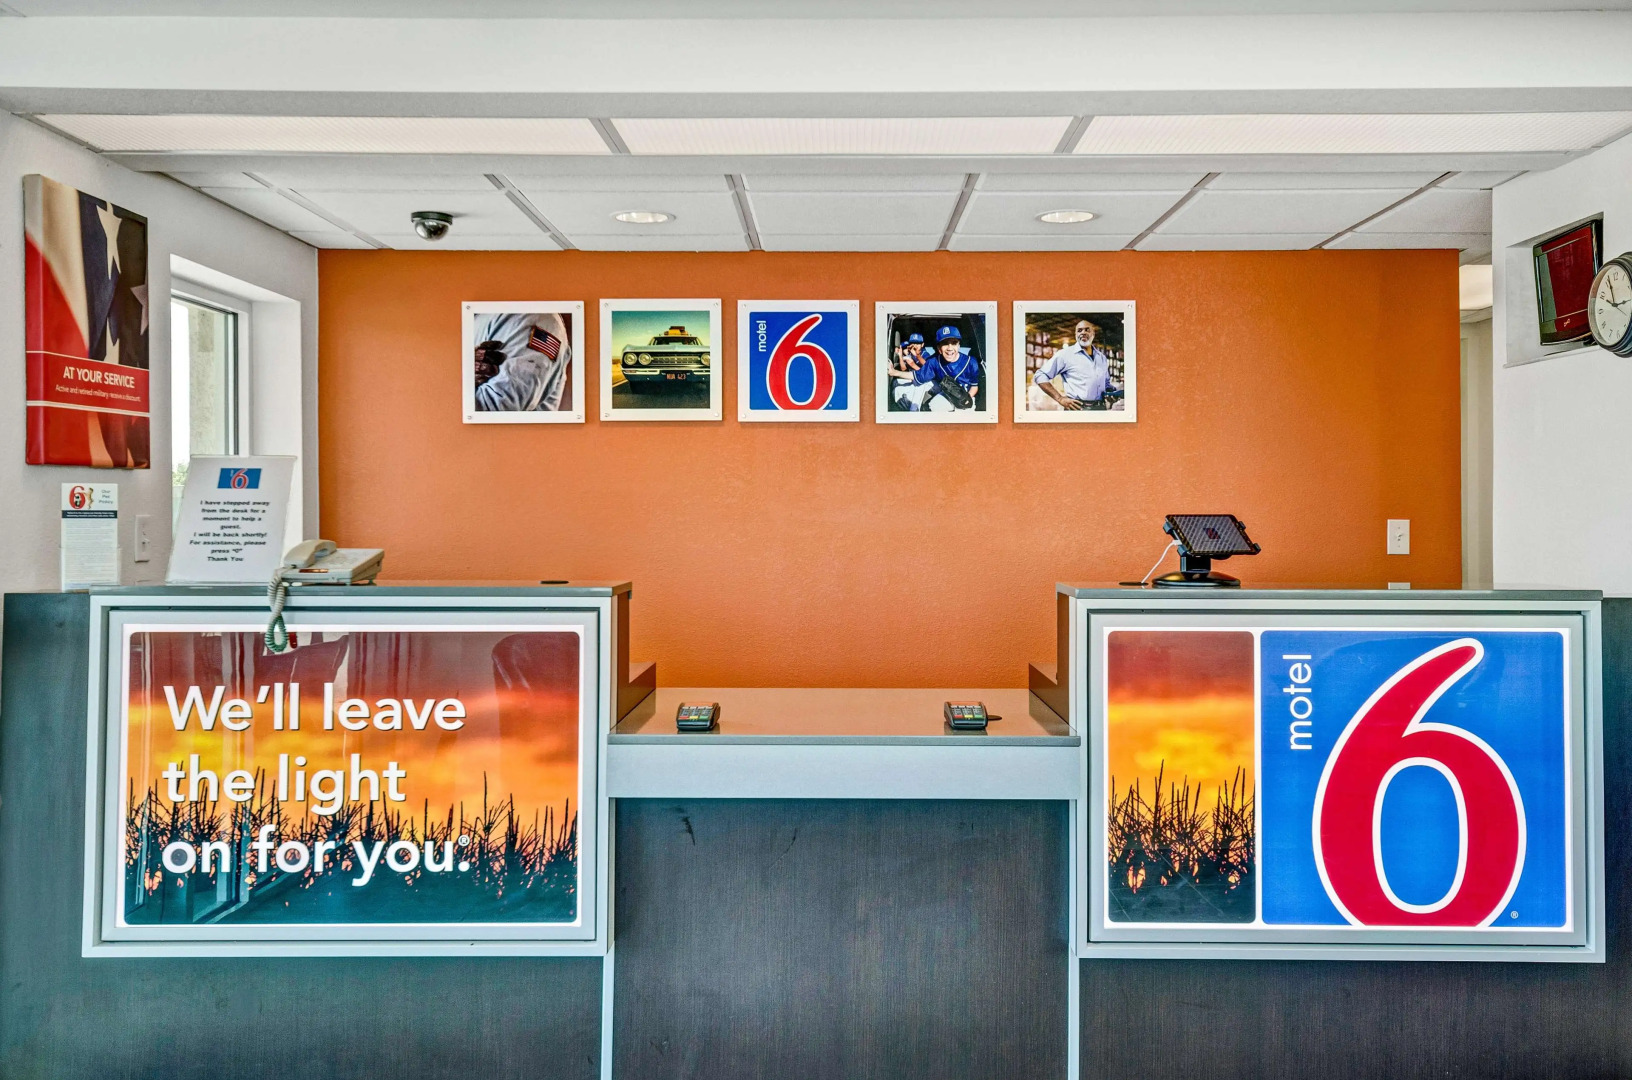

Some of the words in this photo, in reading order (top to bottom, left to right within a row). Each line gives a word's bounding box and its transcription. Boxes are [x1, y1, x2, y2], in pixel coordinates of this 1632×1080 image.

[63, 366, 75, 380] AT
[76, 368, 102, 384] YOUR
[104, 372, 135, 389] SERVICE
[756, 320, 766, 352] motel
[766, 314, 836, 410] 6
[56, 384, 69, 392] Active
[93, 390, 109, 399] military
[69, 486, 86, 509] 6
[230, 468, 249, 489] 6
[163, 682, 300, 731] We’ll
[324, 682, 466, 731] leave
[162, 754, 255, 802] the
[278, 754, 406, 816] light
[1283, 654, 1312, 750] motel
[1312, 638, 1526, 927] 6
[162, 840, 230, 874] on
[254, 824, 336, 874] for
